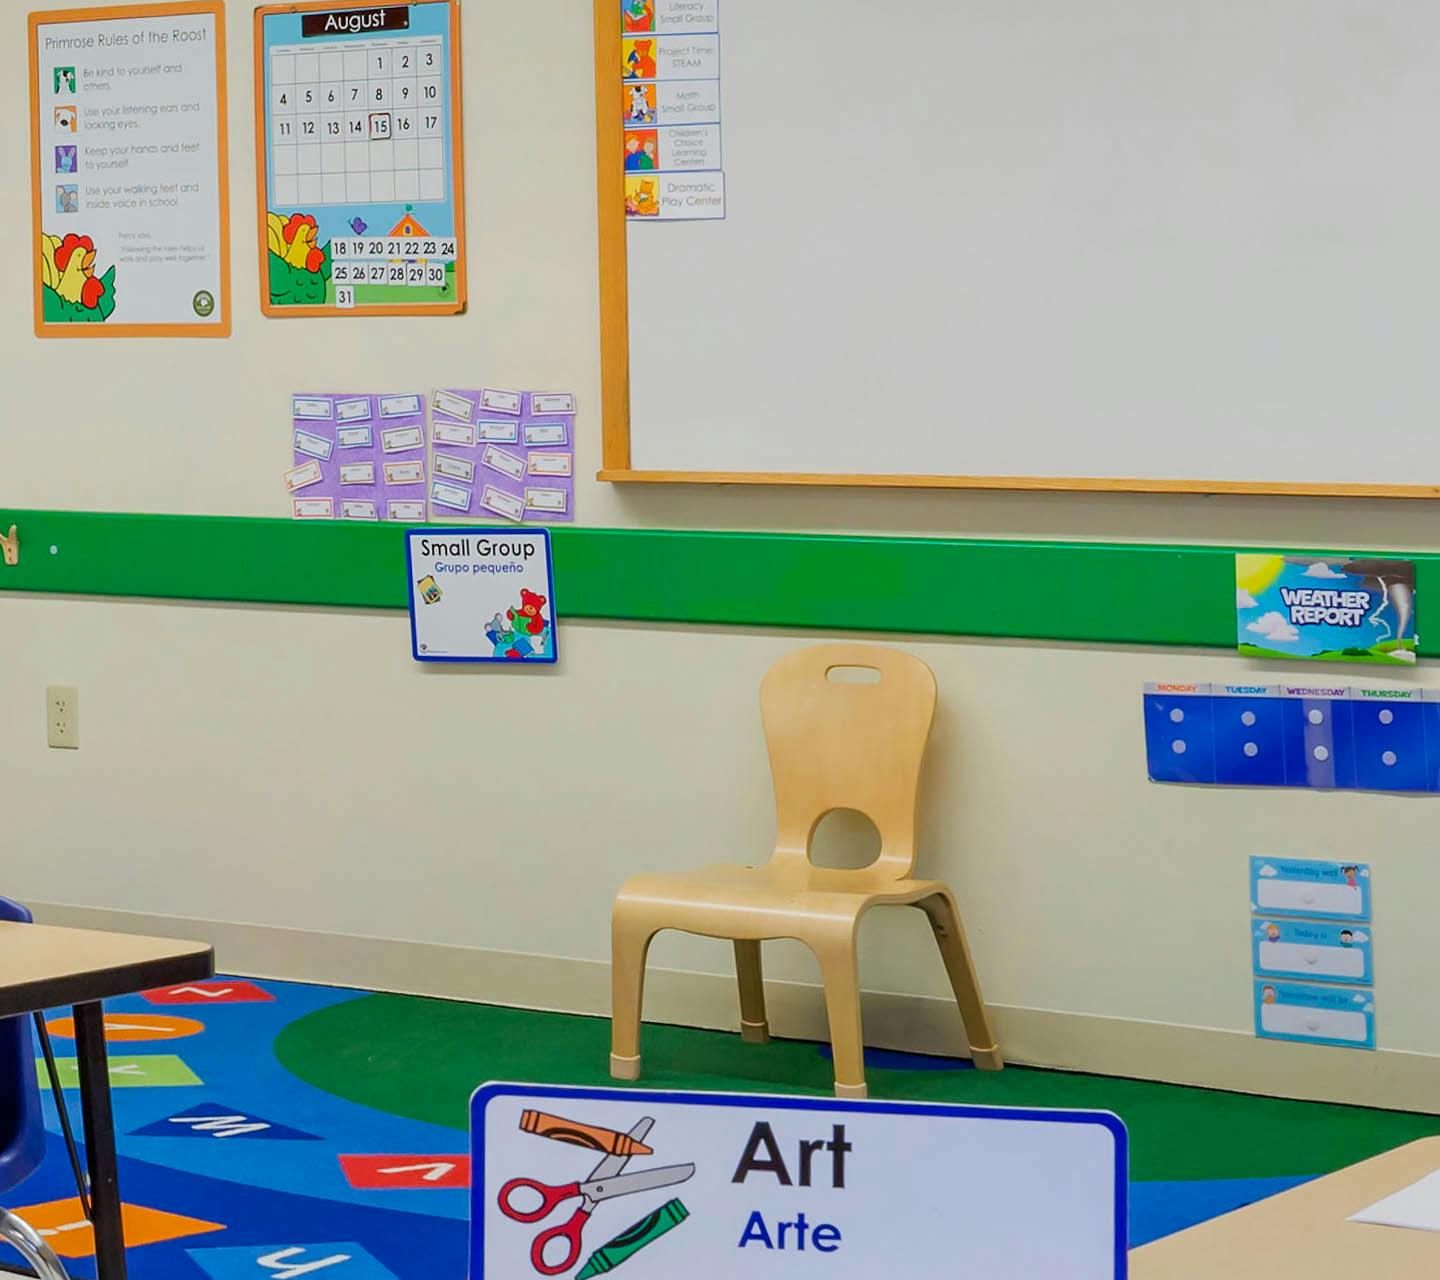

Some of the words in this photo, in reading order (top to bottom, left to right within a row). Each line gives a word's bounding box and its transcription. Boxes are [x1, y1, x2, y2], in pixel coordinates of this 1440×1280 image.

[324, 9, 386, 36] August
[45, 37, 94, 50] Primrose
[98, 33, 129, 47] Rules
[132, 32, 145, 44] of
[148, 30, 169, 43] the
[172, 28, 206, 42] Roost
[377, 57, 383, 69] 1
[402, 56, 409, 69] 2
[426, 54, 433, 66] 3
[280, 93, 287, 105] 4
[305, 91, 312, 103] 5
[328, 90, 335, 102] 6
[351, 89, 358, 101] 7
[375, 89, 383, 101] 8
[402, 87, 409, 99] 9
[424, 86, 437, 98] 10
[280, 123, 291, 135] 11
[303, 122, 314, 134] 12
[328, 122, 340, 134] 13
[349, 121, 362, 133] 14
[375, 121, 387, 133] 15
[398, 118, 410, 131] 16
[425, 117, 437, 129] 17
[668, 183, 715, 193] Dramatic
[334, 243, 346, 255] 18
[353, 243, 364, 255] 19
[369, 242, 384, 255] 20
[388, 242, 401, 255] 21
[405, 242, 419, 255] 22
[423, 242, 437, 255] 23
[441, 243, 454, 255] 24
[335, 267, 348, 280] 25
[353, 267, 365, 280] 26
[371, 268, 385, 280] 27
[390, 268, 404, 281] 28
[410, 269, 423, 282] 29
[428, 269, 443, 281] 30
[339, 291, 352, 304] 31
[421, 539, 470, 557] Small
[477, 539, 535, 560] Group
[435, 562, 469, 574] Grupo
[473, 562, 523, 575] pequeño
[1281, 588, 1369, 609] WEATHER
[1291, 607, 1364, 625] REPORT
[1157, 684, 1196, 692] MONDAY
[1225, 685, 1267, 694] TUESDAY
[1287, 686, 1345, 697] WEDNESDAY
[1360, 689, 1412, 698] THURSDAY
[731, 1121, 852, 1189] Art
[738, 1211, 842, 1253] Arte
